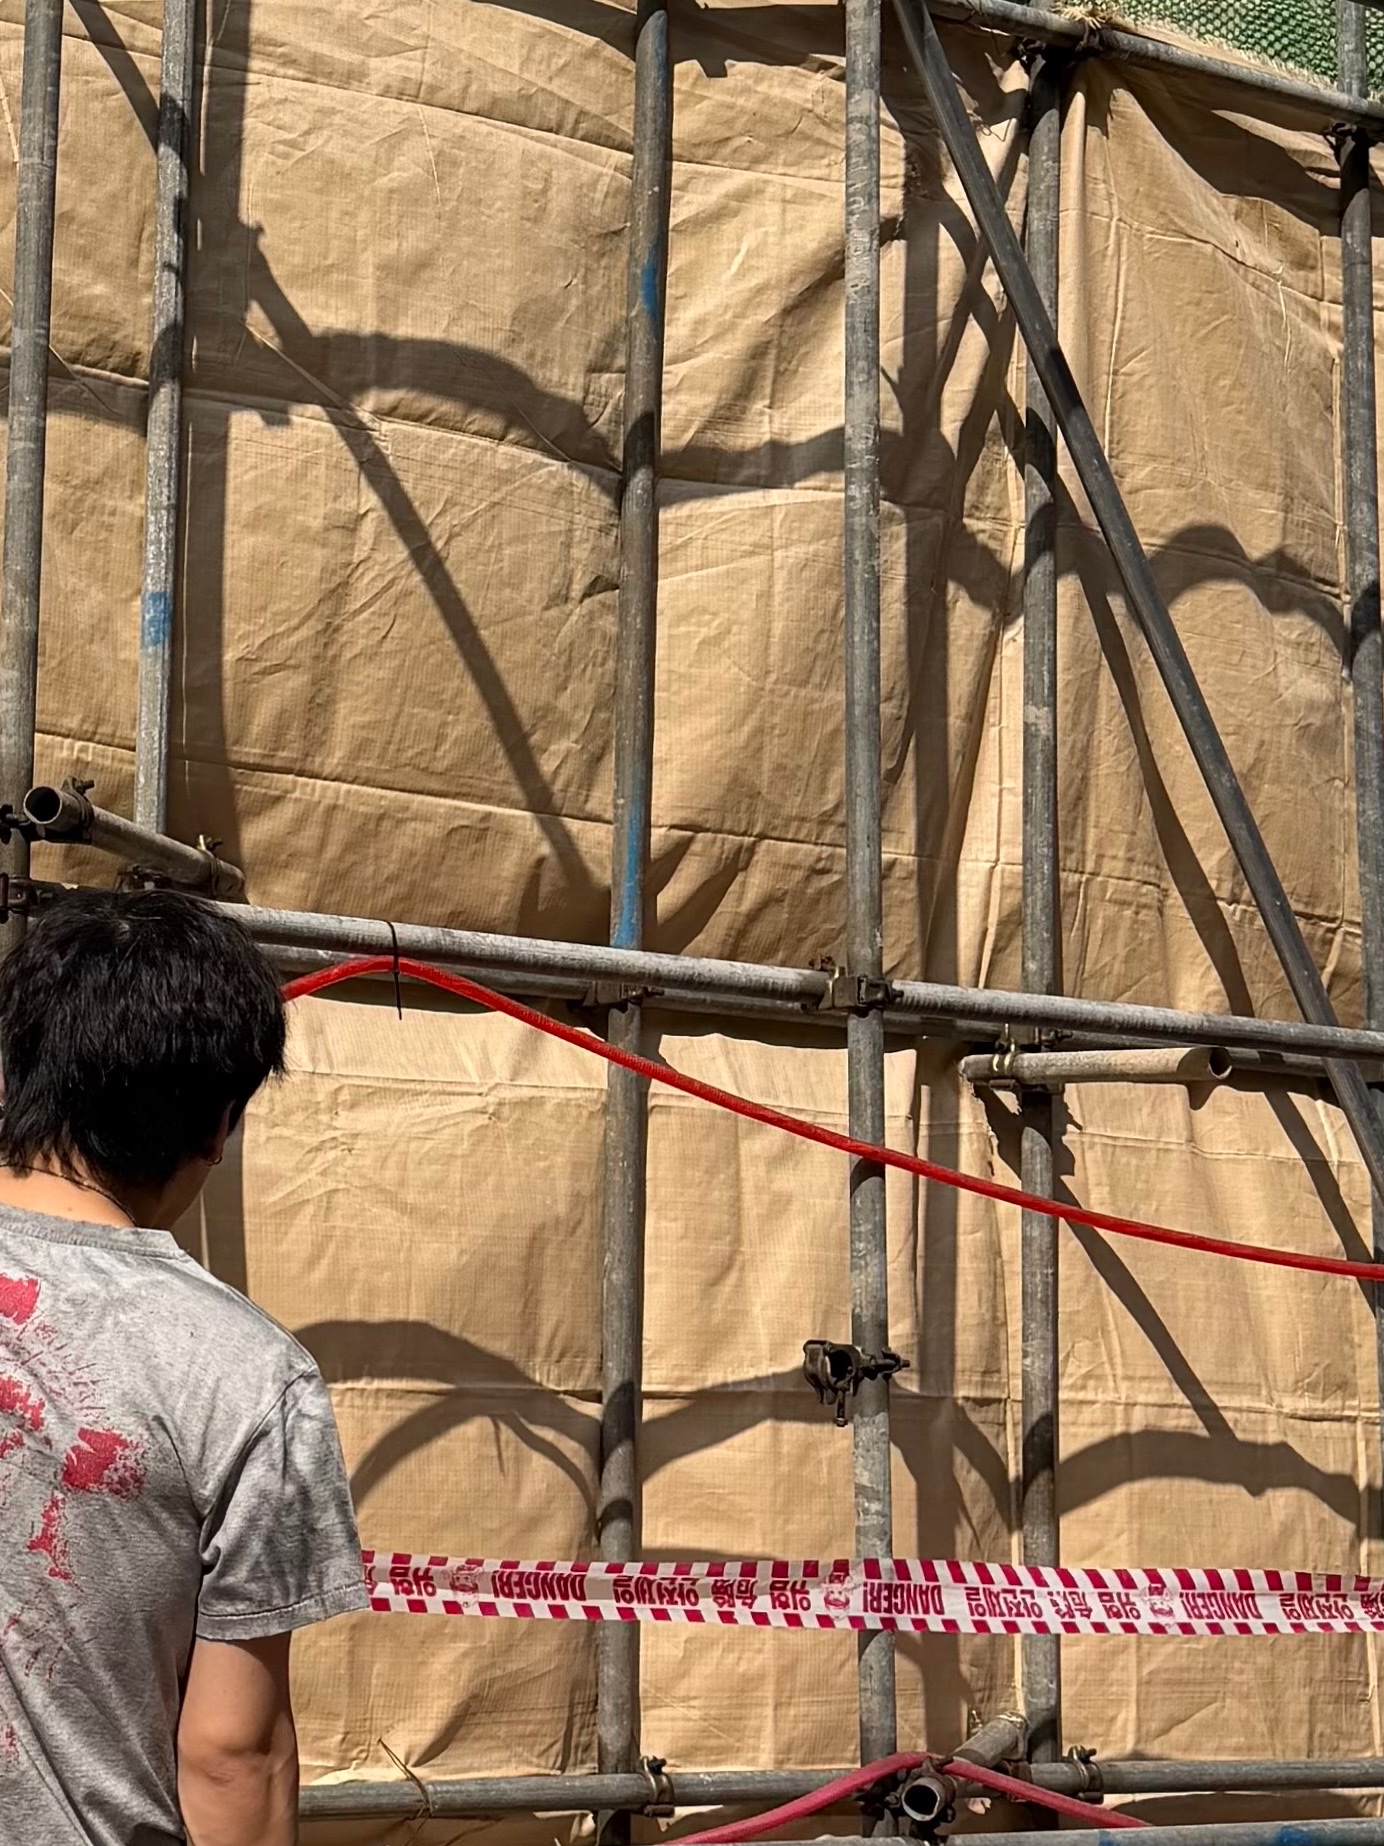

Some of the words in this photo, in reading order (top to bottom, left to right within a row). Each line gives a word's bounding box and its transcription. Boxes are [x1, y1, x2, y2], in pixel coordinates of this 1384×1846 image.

[389, 1565, 437, 1597] 위험
[491, 1570, 587, 1601] DANGER!
[613, 1575, 700, 1606] 안전제일
[711, 1578, 758, 1609] 危險
[769, 1580, 812, 1611] 위험
[863, 1581, 945, 1616] DANGER!
[964, 1586, 1044, 1618] 안전제일
[1097, 1592, 1142, 1620] 위험
[1179, 1592, 1264, 1620] DANGER!
[1279, 1592, 1355, 1621] 안전제일
